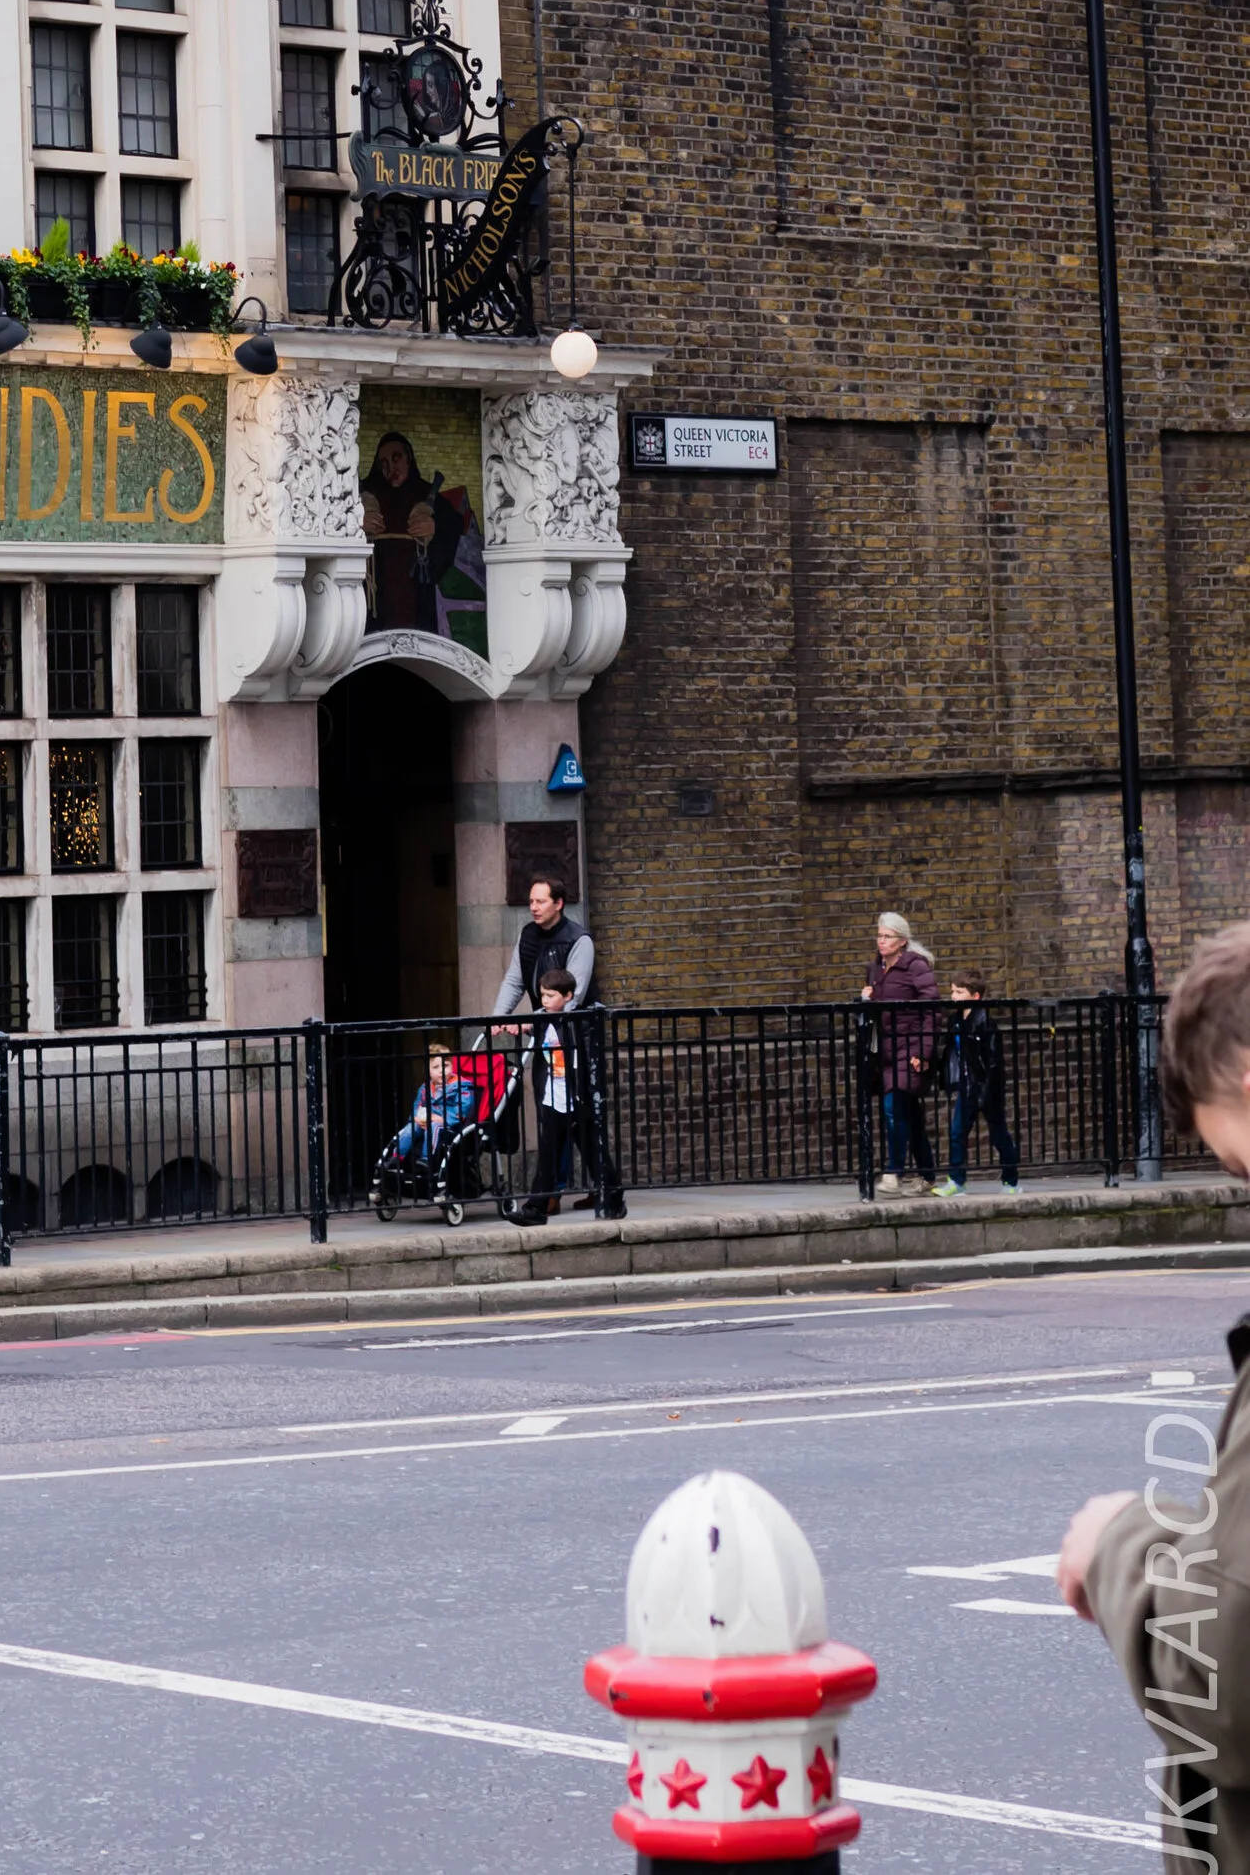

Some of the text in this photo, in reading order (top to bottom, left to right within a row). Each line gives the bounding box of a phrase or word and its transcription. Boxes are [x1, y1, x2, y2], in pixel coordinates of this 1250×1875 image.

[372, 151, 503, 191] The BLACK FRIA
[444, 148, 537, 304] NICHOLSON'S
[673, 427, 769, 443] QUEEN VICTORIA
[674, 444, 769, 460] STREET EC4
